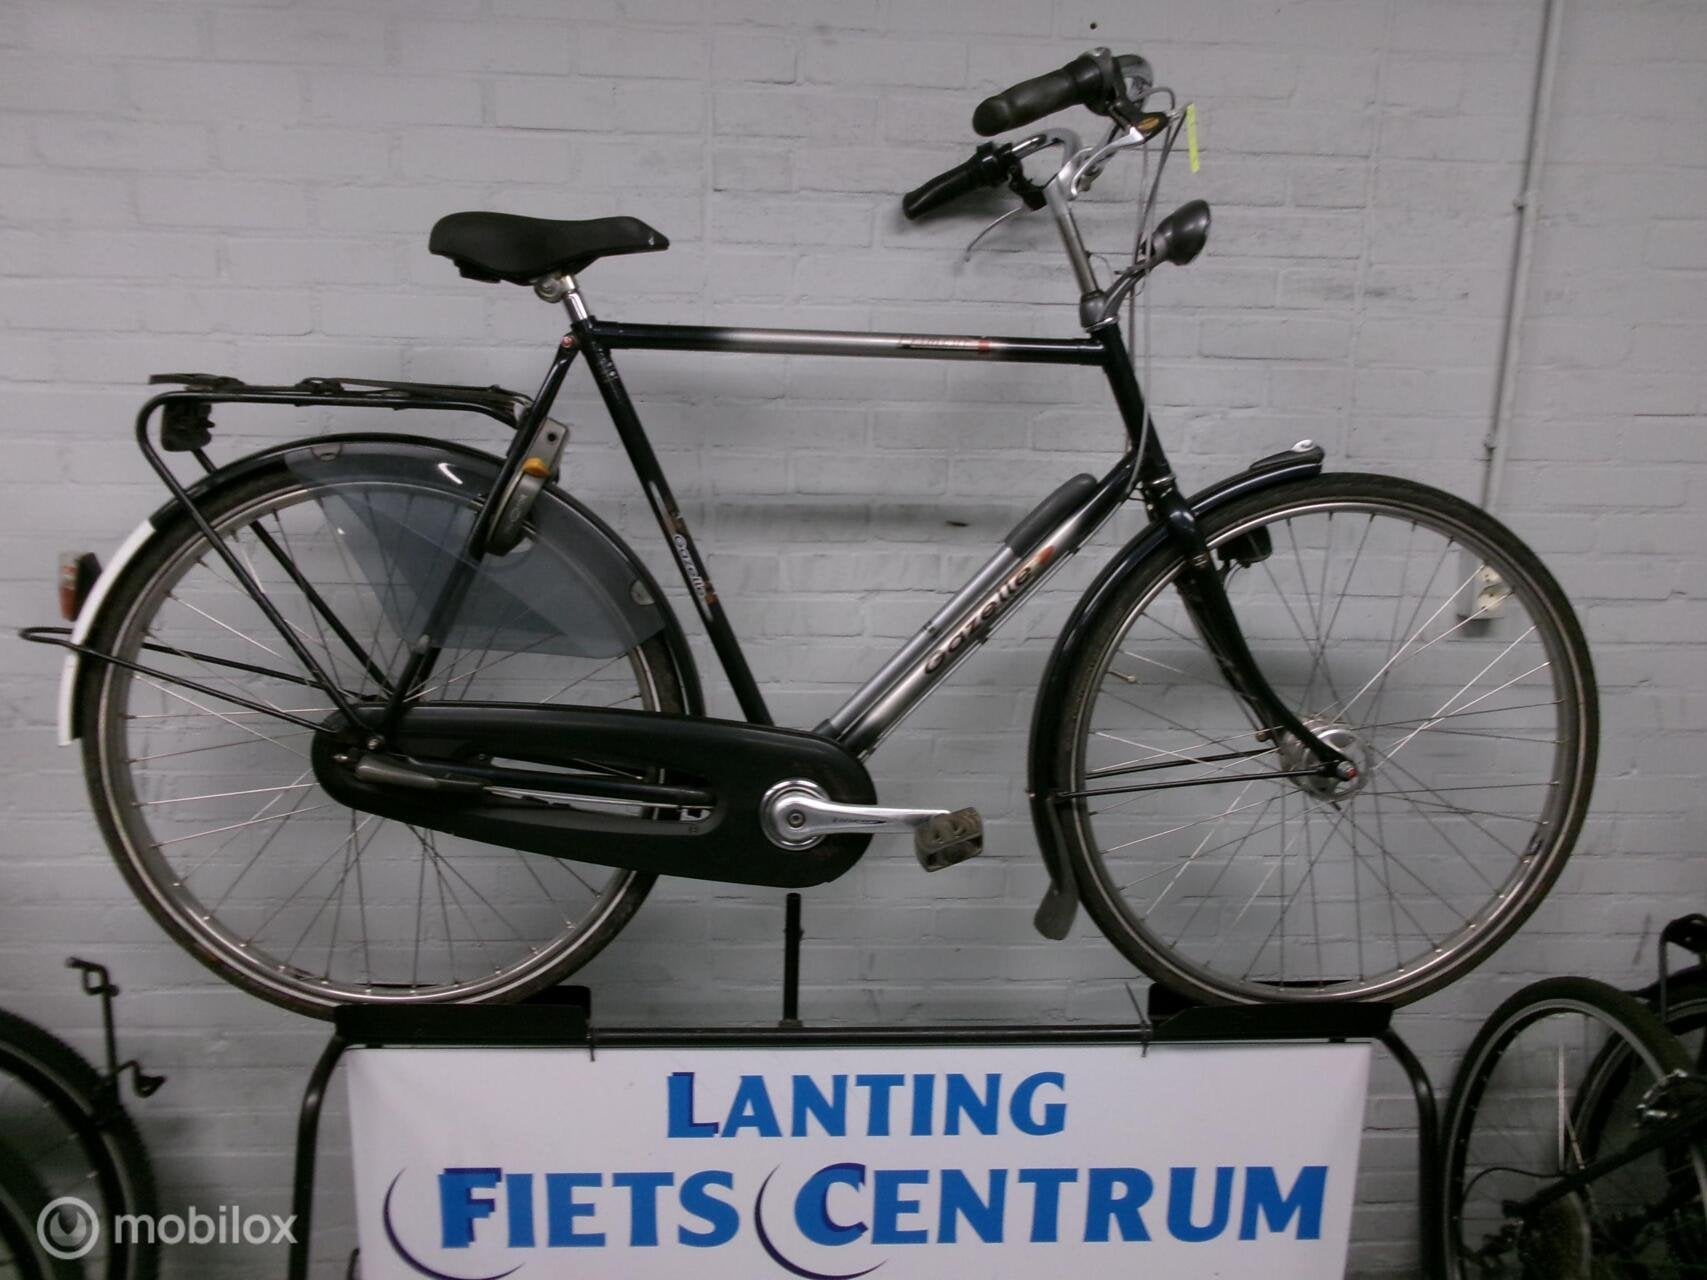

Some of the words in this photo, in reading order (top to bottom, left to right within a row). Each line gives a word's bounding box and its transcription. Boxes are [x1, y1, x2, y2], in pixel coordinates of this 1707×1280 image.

[667, 1072, 1068, 1140] LANTING
[439, 1167, 740, 1249] FIETS
[793, 1164, 1328, 1248] CENTRUM
